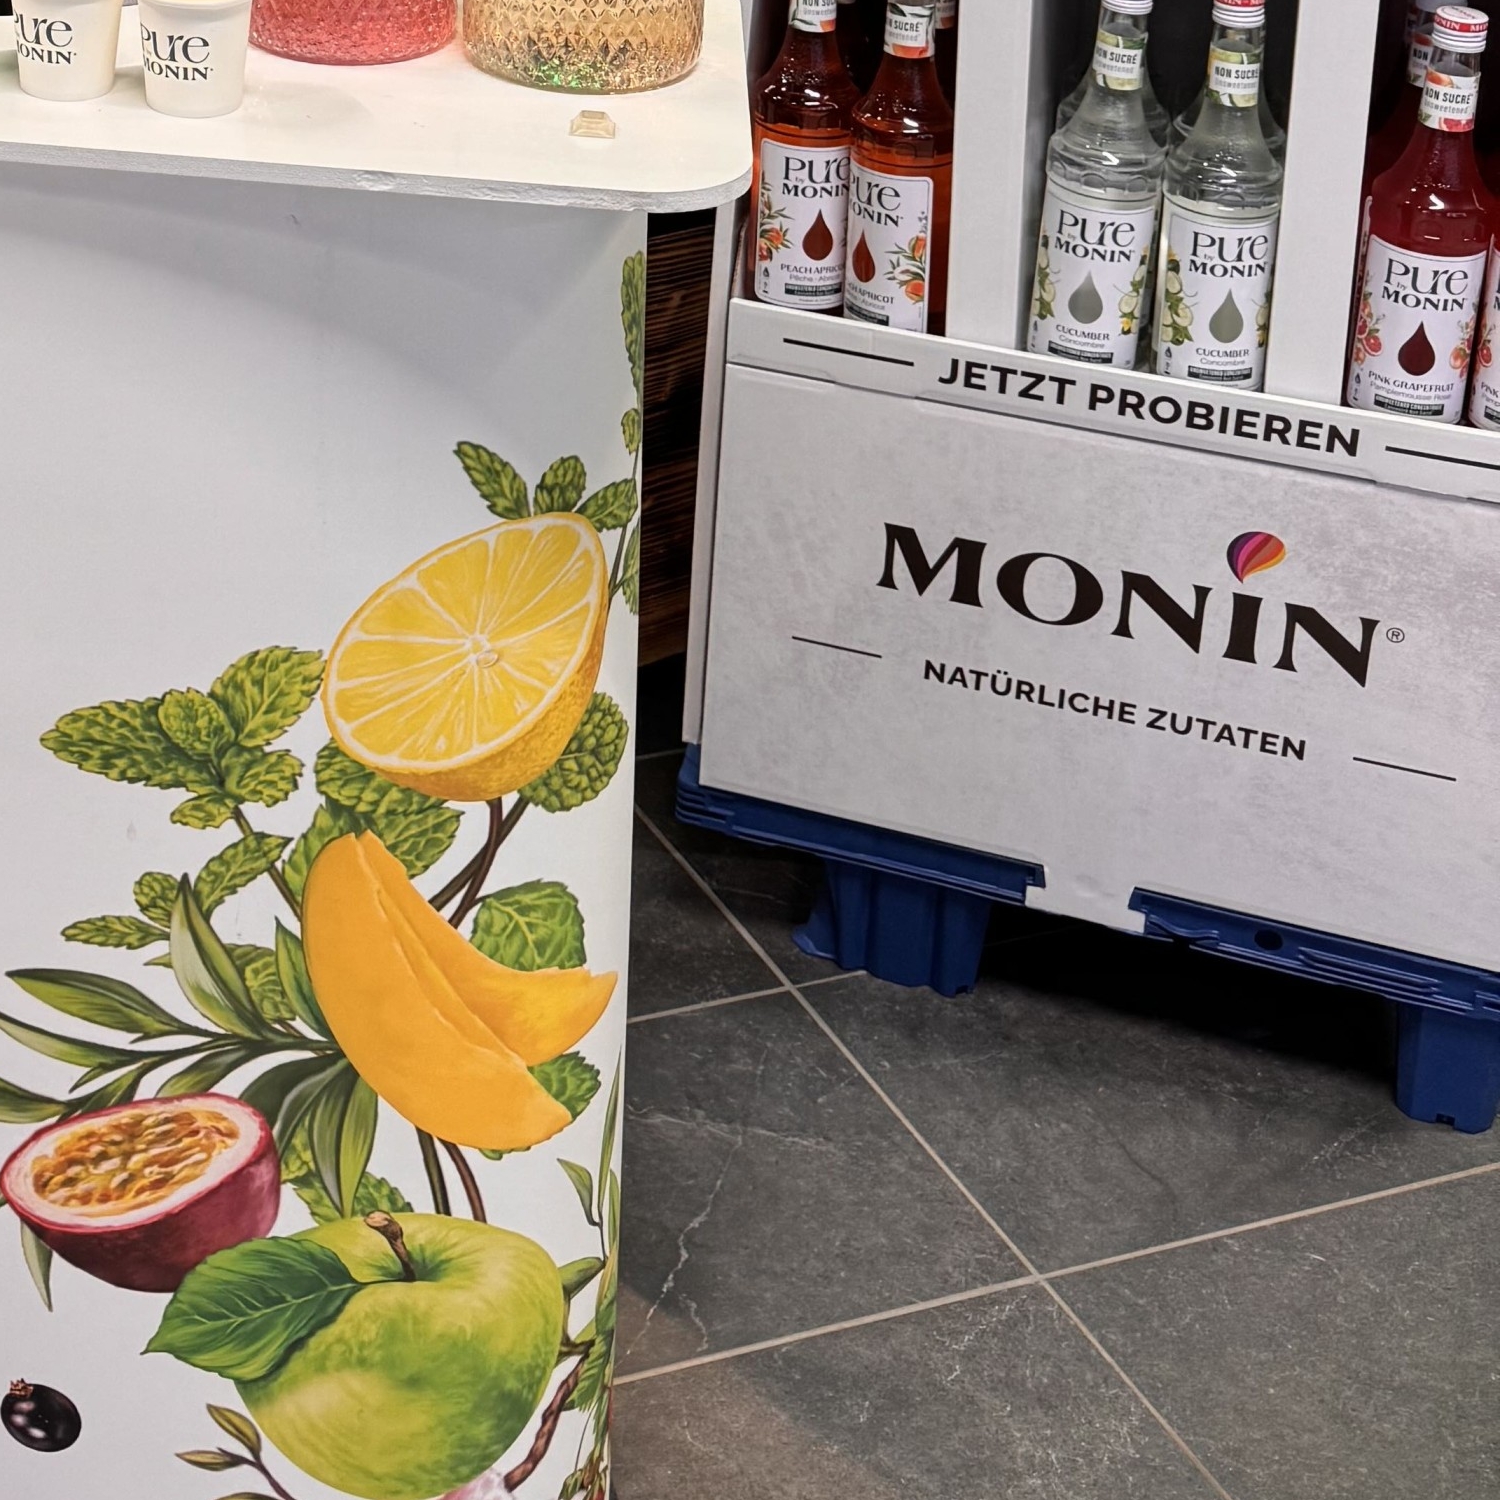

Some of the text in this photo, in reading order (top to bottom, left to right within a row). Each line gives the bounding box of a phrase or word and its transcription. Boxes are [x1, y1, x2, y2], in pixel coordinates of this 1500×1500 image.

[1109, 52, 1137, 64] SUCRÉ
[1215, 66, 1232, 78] NON
[852, 202, 899, 228] ONIN
[1057, 210, 1135, 247] Pure
[1054, 237, 1132, 263] MONIN
[1192, 231, 1268, 263] Pure
[781, 263, 812, 274] PEACH
[1189, 260, 1266, 278] MONIN
[1385, 258, 1468, 295] Pure
[1382, 286, 1465, 312] MONIN
[1056, 325, 1110, 341] CUCUMBER
[1059, 336, 1105, 349] Concombre
[1195, 348, 1249, 357] CUCUMBER
[1200, 357, 1245, 365] Concombre
[1369, 370, 1454, 392] PINK GRAPEFRUIT
[938, 358, 1360, 457] JETZT PROBIEREN
[923, 659, 1305, 761] NATÜRLICHE ZUTATEN
